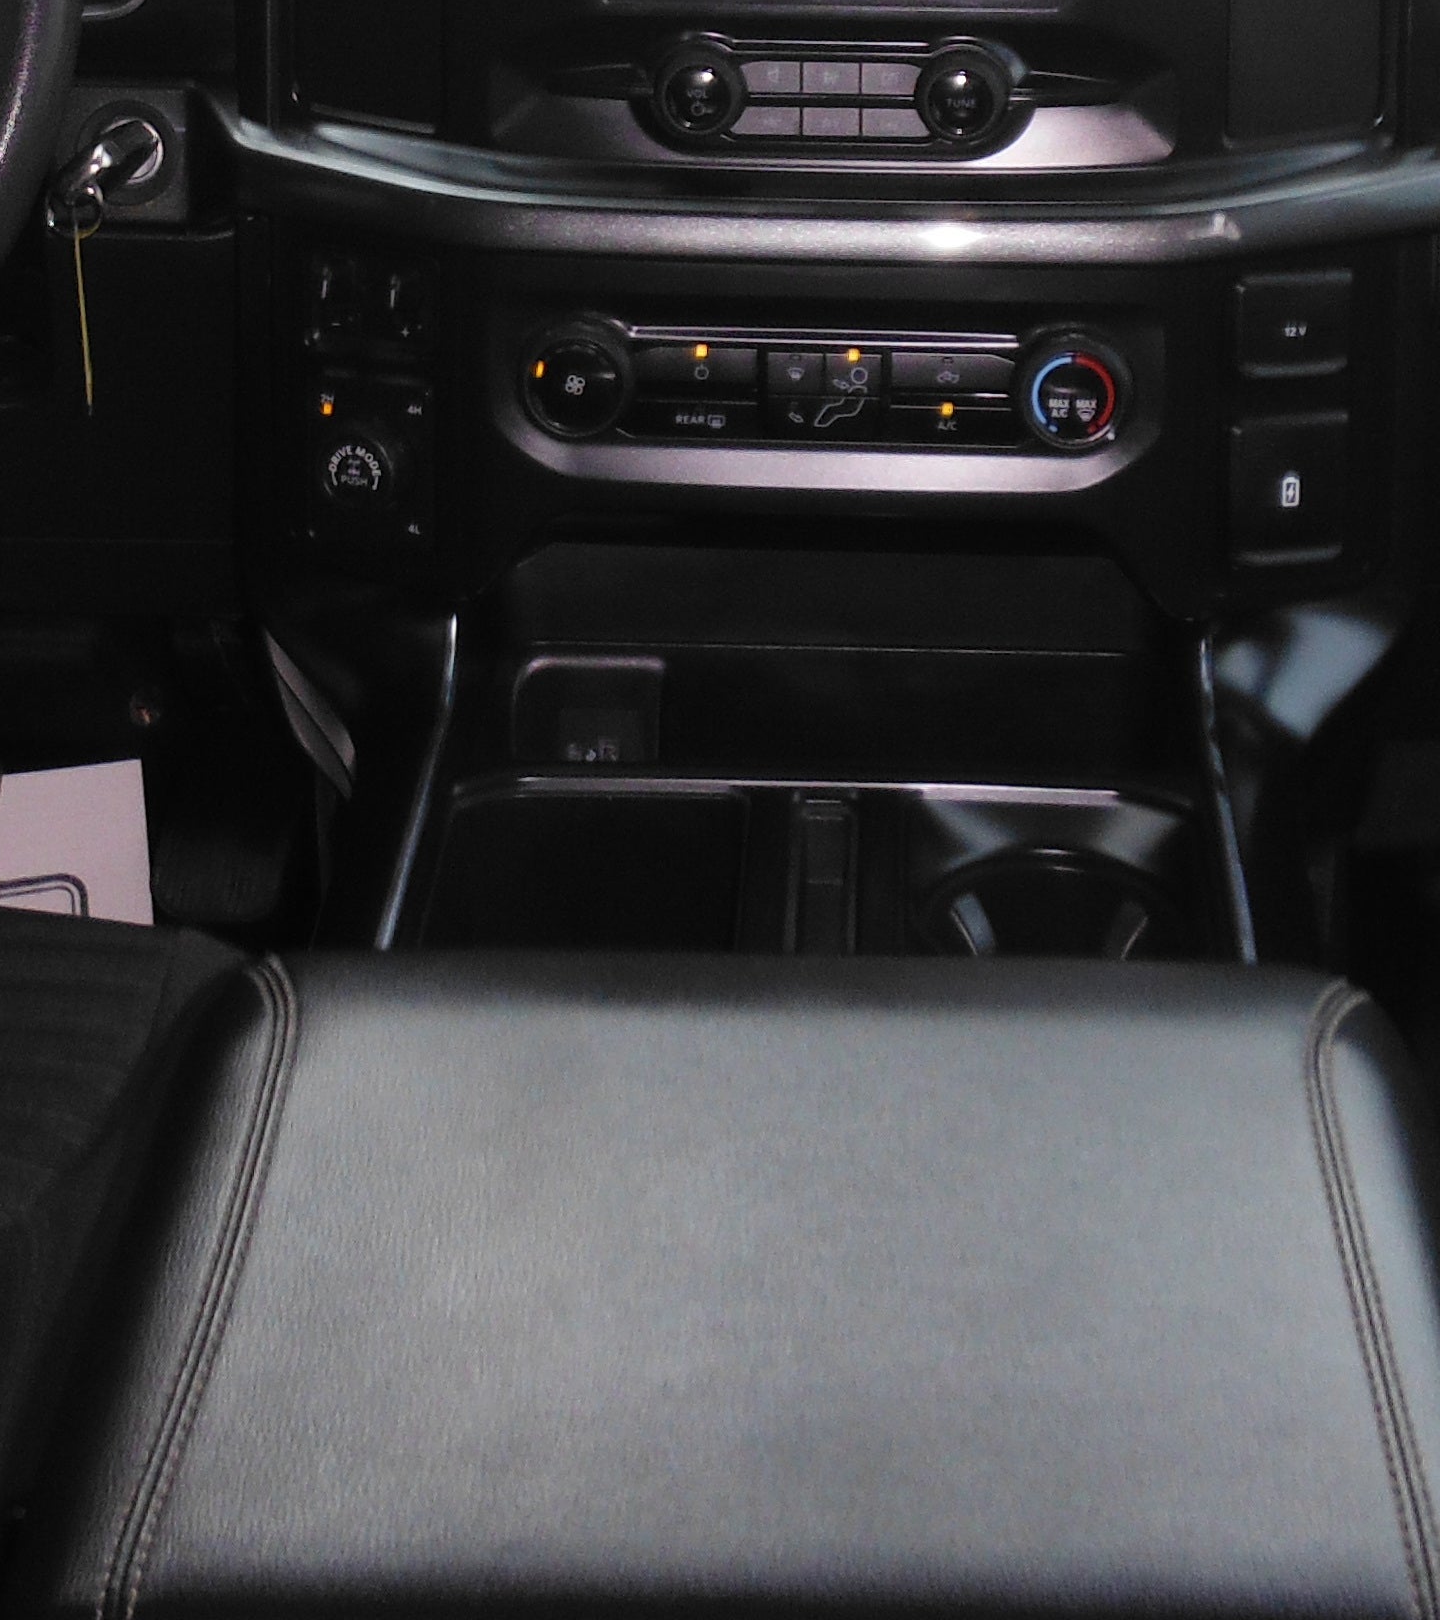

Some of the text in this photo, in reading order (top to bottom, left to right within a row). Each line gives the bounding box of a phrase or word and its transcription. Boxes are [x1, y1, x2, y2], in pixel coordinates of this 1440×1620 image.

[687, 89, 709, 99] VOL
[1048, 398, 1071, 408] MAX
[1075, 398, 1098, 409] MAX
[675, 414, 706, 426] REAR
[936, 420, 958, 432] A/C
[328, 445, 383, 477] DRIVE MODE
